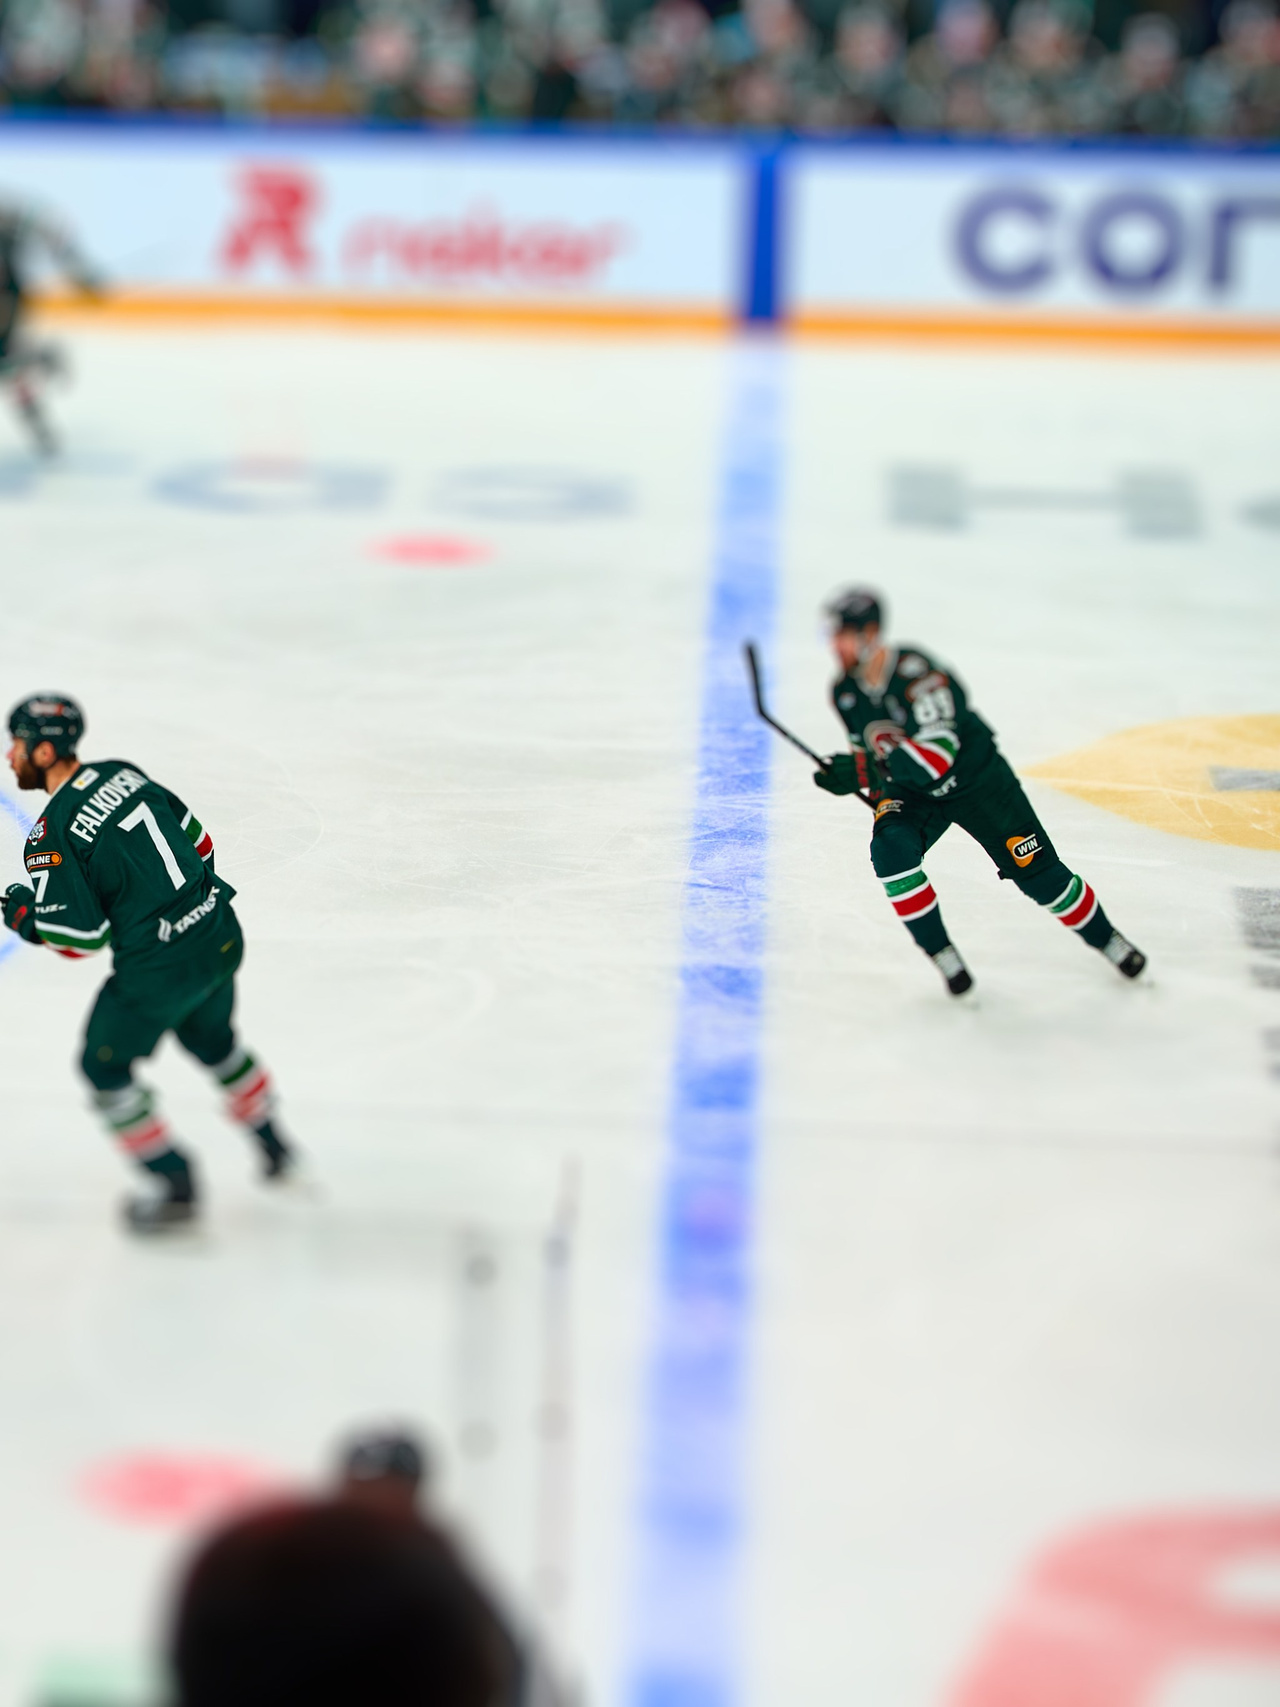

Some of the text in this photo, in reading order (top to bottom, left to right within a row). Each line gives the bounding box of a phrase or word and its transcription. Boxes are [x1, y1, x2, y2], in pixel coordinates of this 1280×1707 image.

[117, 800, 187, 891] 7
[1017, 837, 1039, 856] WIN
[30, 869, 50, 903] 7
